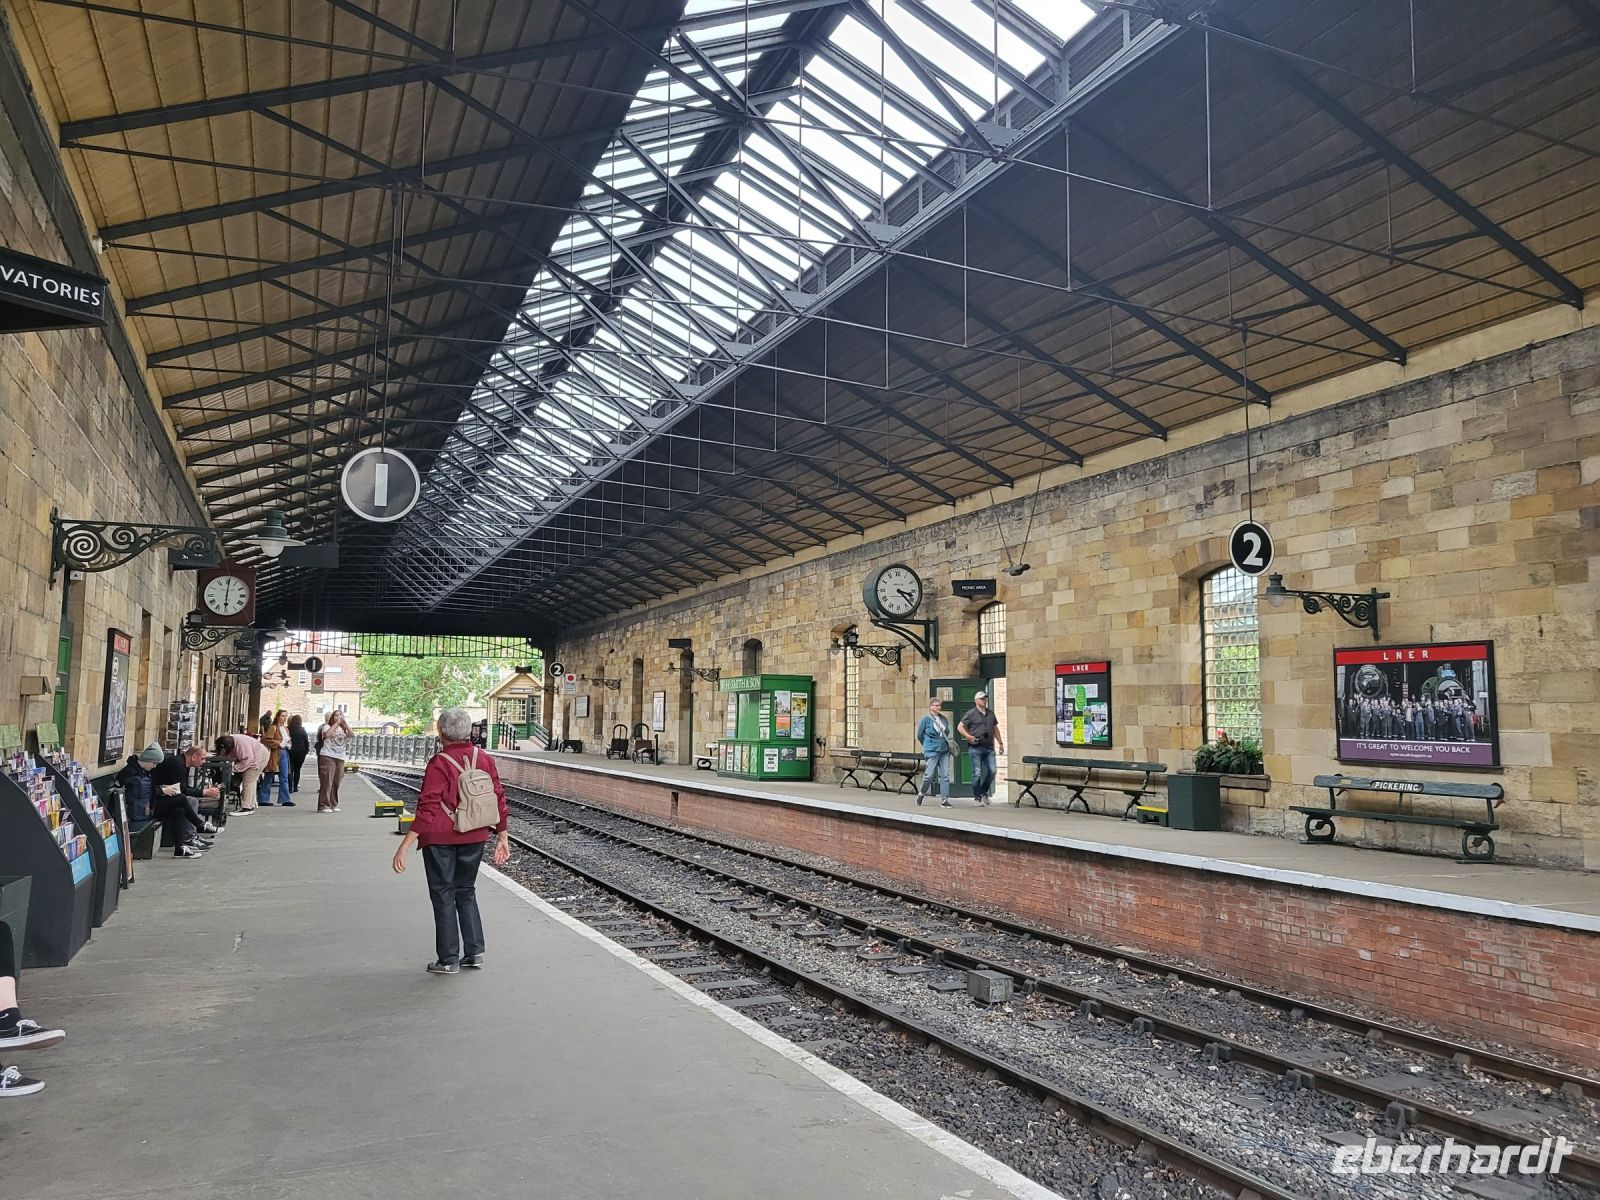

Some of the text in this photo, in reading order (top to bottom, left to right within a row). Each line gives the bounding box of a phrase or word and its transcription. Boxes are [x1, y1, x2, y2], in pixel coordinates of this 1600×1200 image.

[1242, 532, 1263, 566] 2
[1383, 650, 1429, 661] LNER
[554, 665, 561, 675] 2
[1374, 782, 1420, 791] PICKERING
